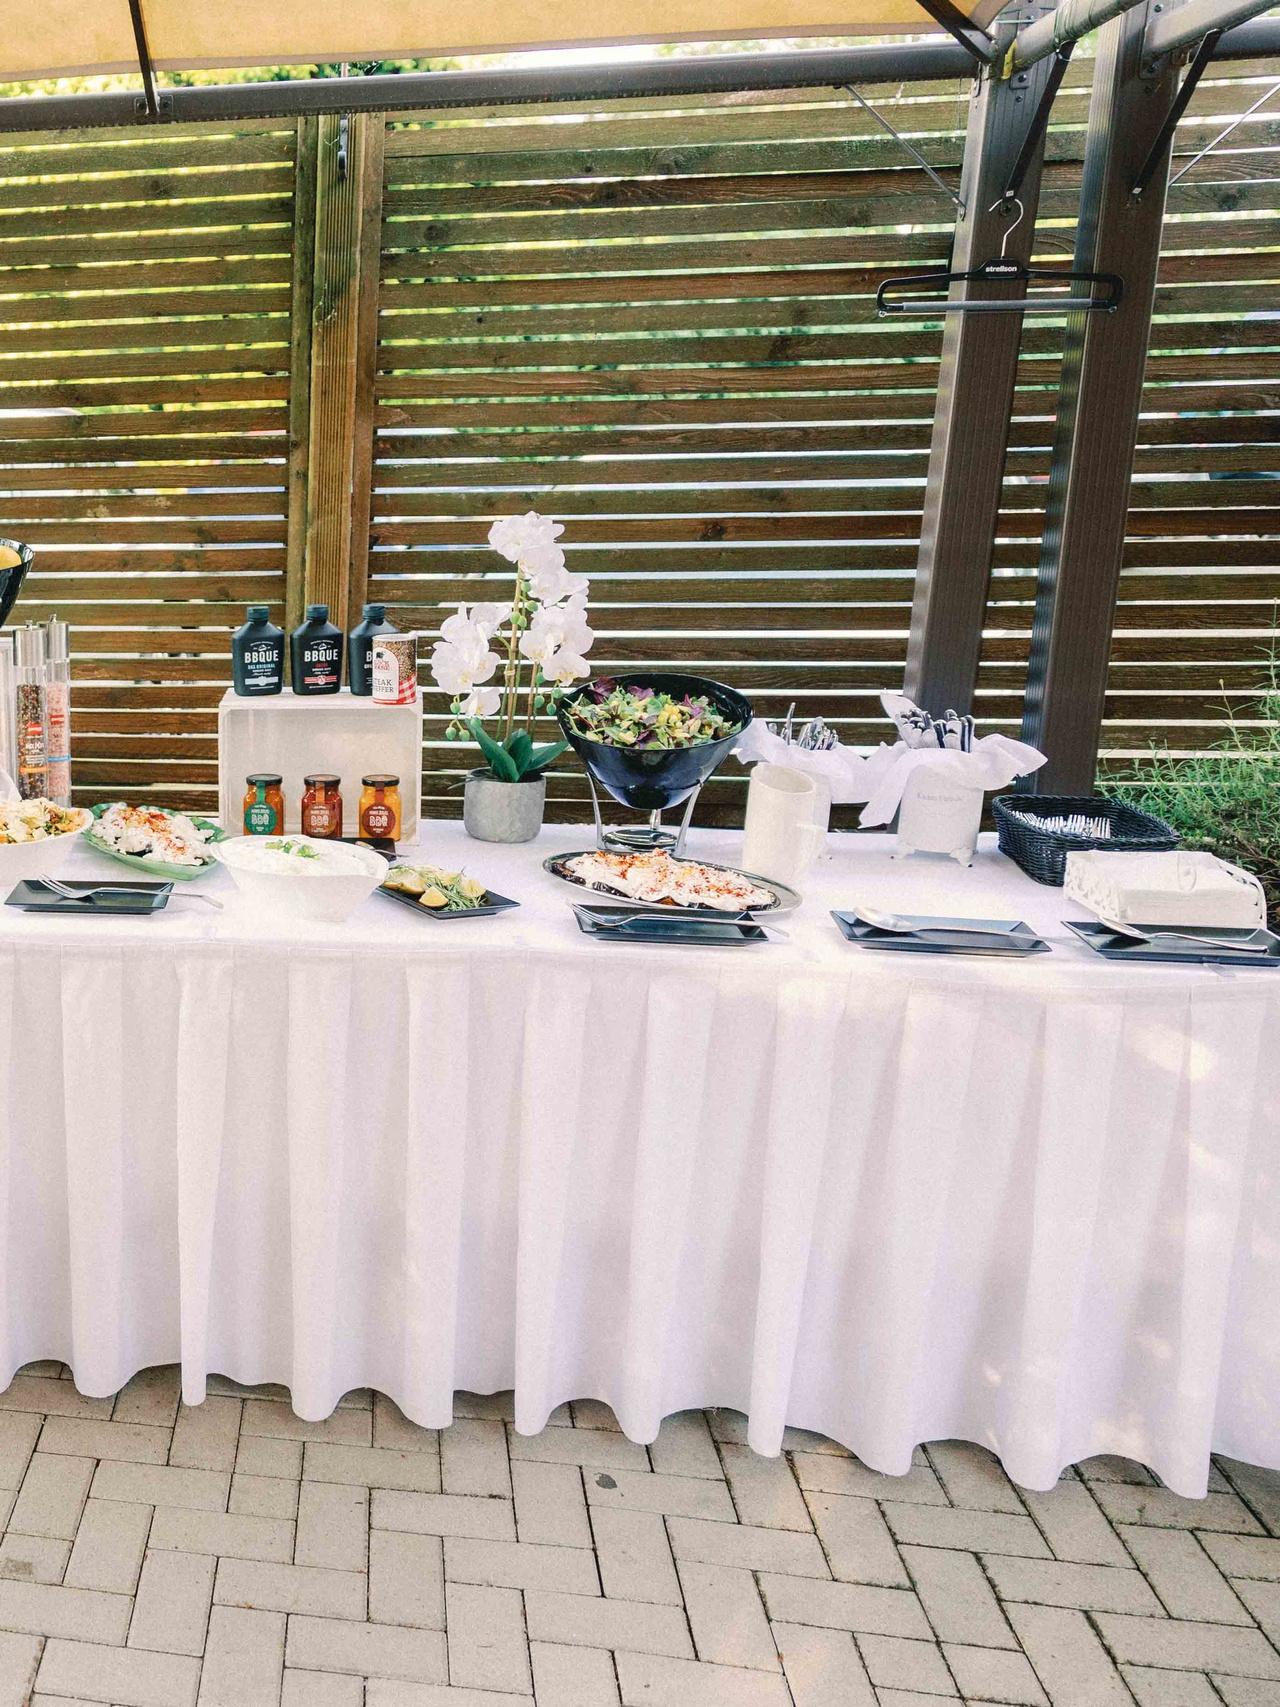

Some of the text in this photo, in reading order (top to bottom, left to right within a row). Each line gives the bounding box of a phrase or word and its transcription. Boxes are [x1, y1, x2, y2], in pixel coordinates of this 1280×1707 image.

[244, 650, 279, 664] BBQUE
[304, 649, 338, 662] BBQUE
[372, 678, 392, 686] TEAK
[251, 814, 269, 825] BBQ
[310, 815, 329, 826] BBQ
[369, 815, 388, 827] BBQ
